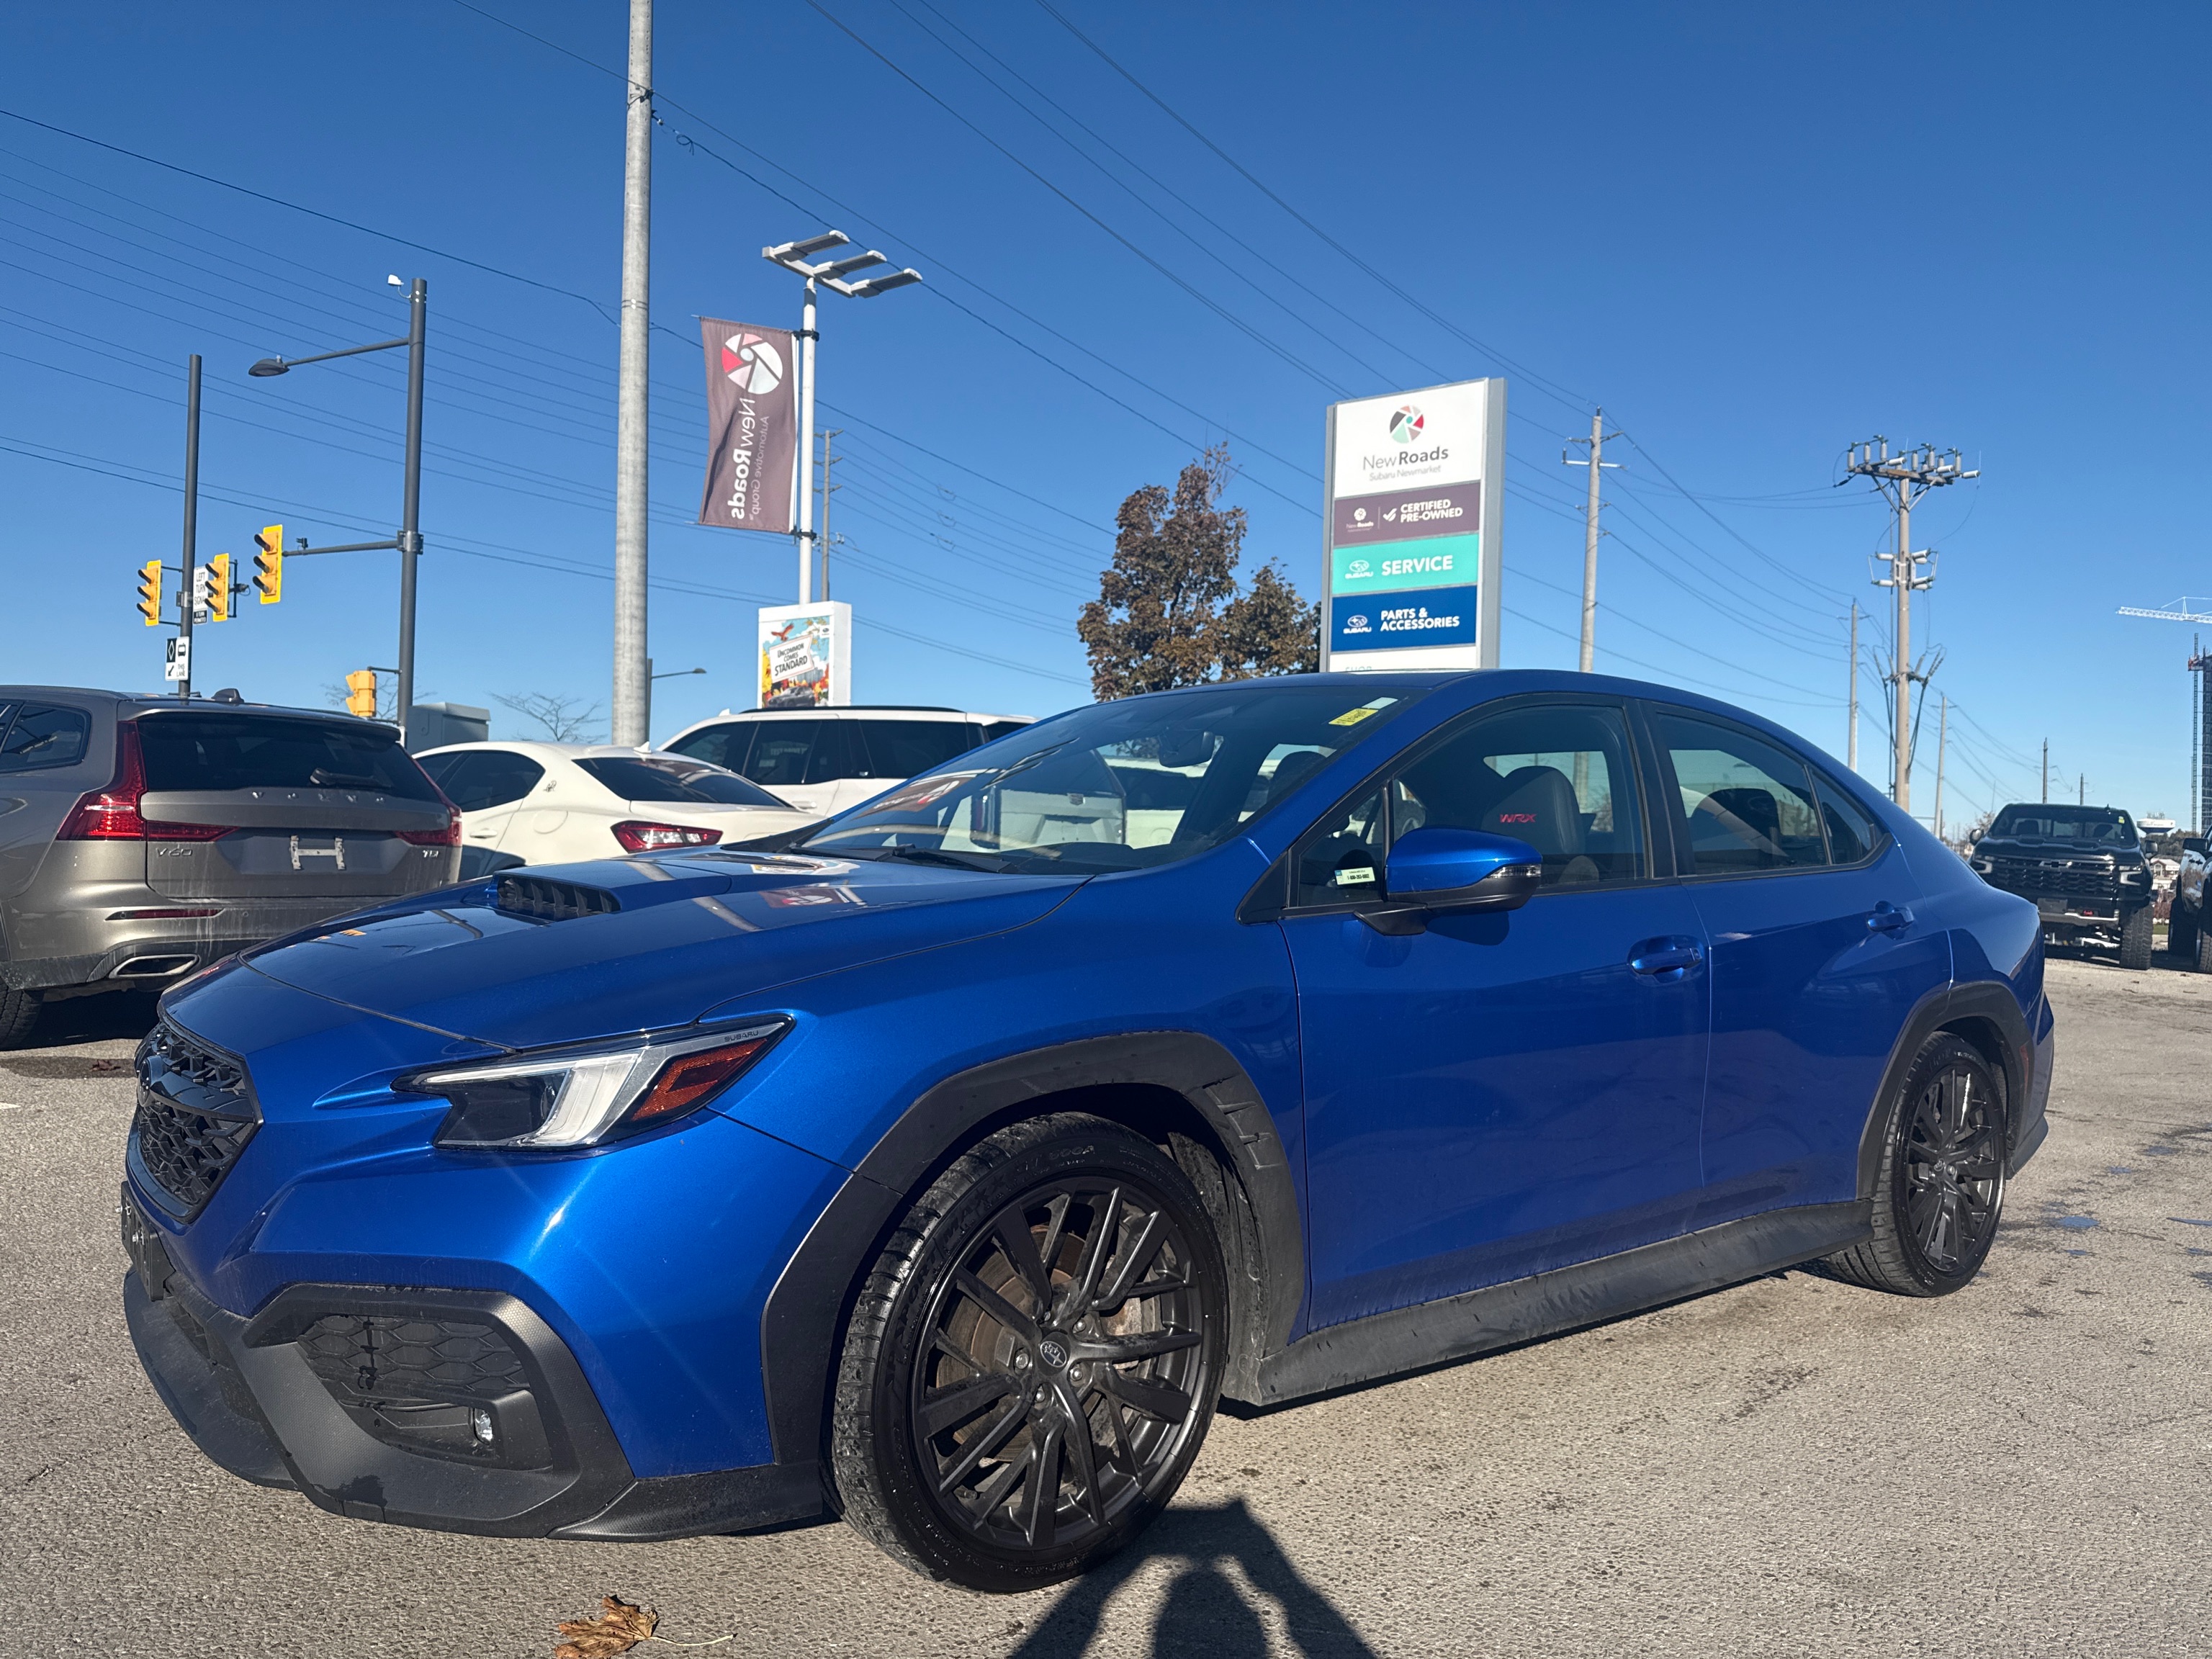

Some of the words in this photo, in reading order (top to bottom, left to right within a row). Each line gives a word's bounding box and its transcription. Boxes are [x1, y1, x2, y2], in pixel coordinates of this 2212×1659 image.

[1370, 472, 1395, 481] Subaru
[1397, 465, 1441, 477] Newmarket
[1400, 498, 1452, 513] CERTIFIED
[1400, 507, 1463, 523] PRE-OWNED
[1382, 554, 1453, 577] SERVICE
[196, 572, 205, 582] LEFT
[196, 584, 205, 593] TURN
[1380, 608, 1416, 621] PARTS
[1419, 607, 1428, 619] &
[1380, 616, 1460, 632] ACCESSORIES
[775, 655, 807, 676] STANDARD
[1499, 814, 1537, 823] WRX
[155, 848, 193, 857] V60
[724, 1030, 759, 1042] SUBARU
